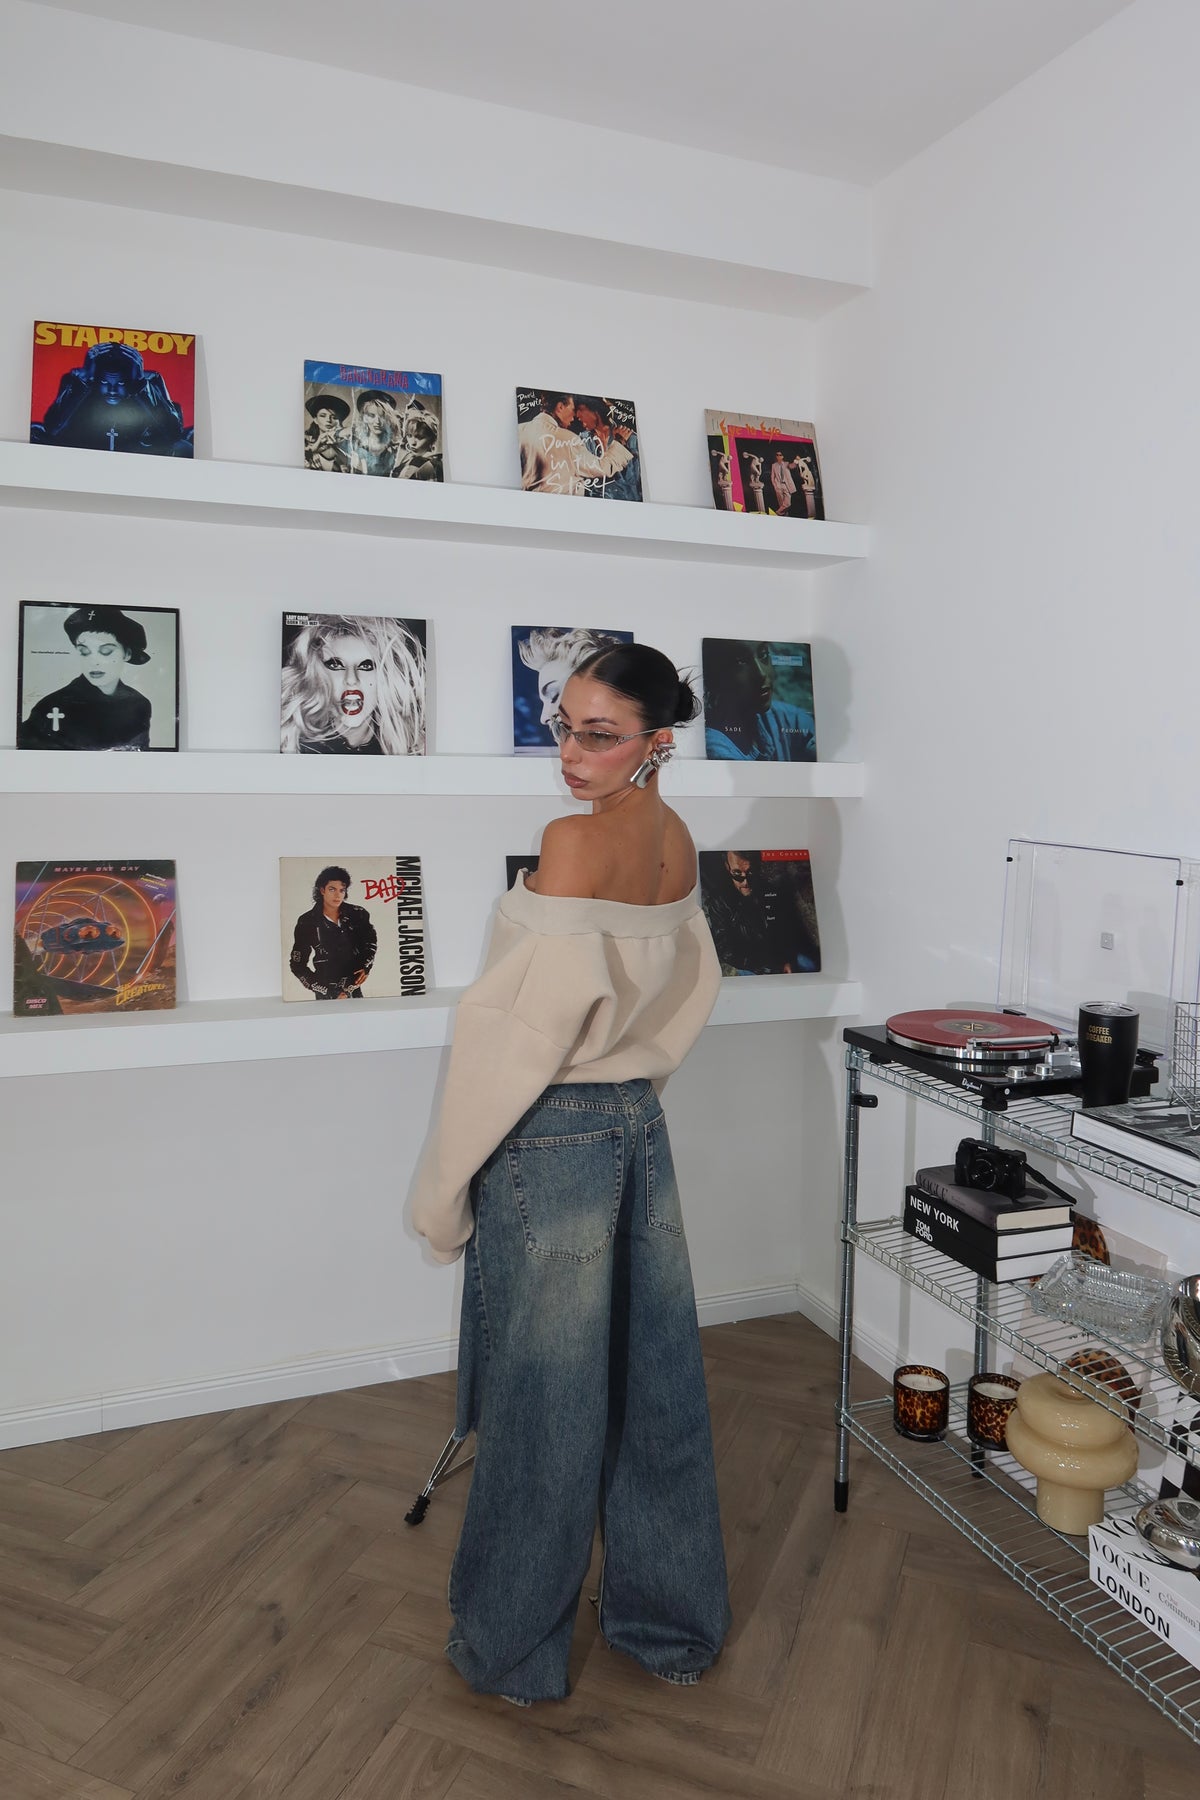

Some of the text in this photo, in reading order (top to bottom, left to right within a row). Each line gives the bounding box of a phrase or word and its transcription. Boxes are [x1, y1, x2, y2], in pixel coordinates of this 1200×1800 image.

[35, 322, 194, 355] STARBOY
[518, 398, 543, 415] Bowie
[540, 434, 604, 460] Dancing
[550, 454, 570, 471] in
[360, 874, 406, 904] BAD
[395, 856, 424, 924] MICHAEL
[398, 925, 426, 996] JACKSON
[1089, 1025, 1110, 1036] COFFEE
[910, 1195, 932, 1216] NEW
[933, 1207, 960, 1233] YORK
[915, 1219, 931, 1233] TOM
[915, 1226, 934, 1242] FORD
[1091, 1534, 1151, 1594] VOGUE
[1097, 1566, 1171, 1640] LONDON
